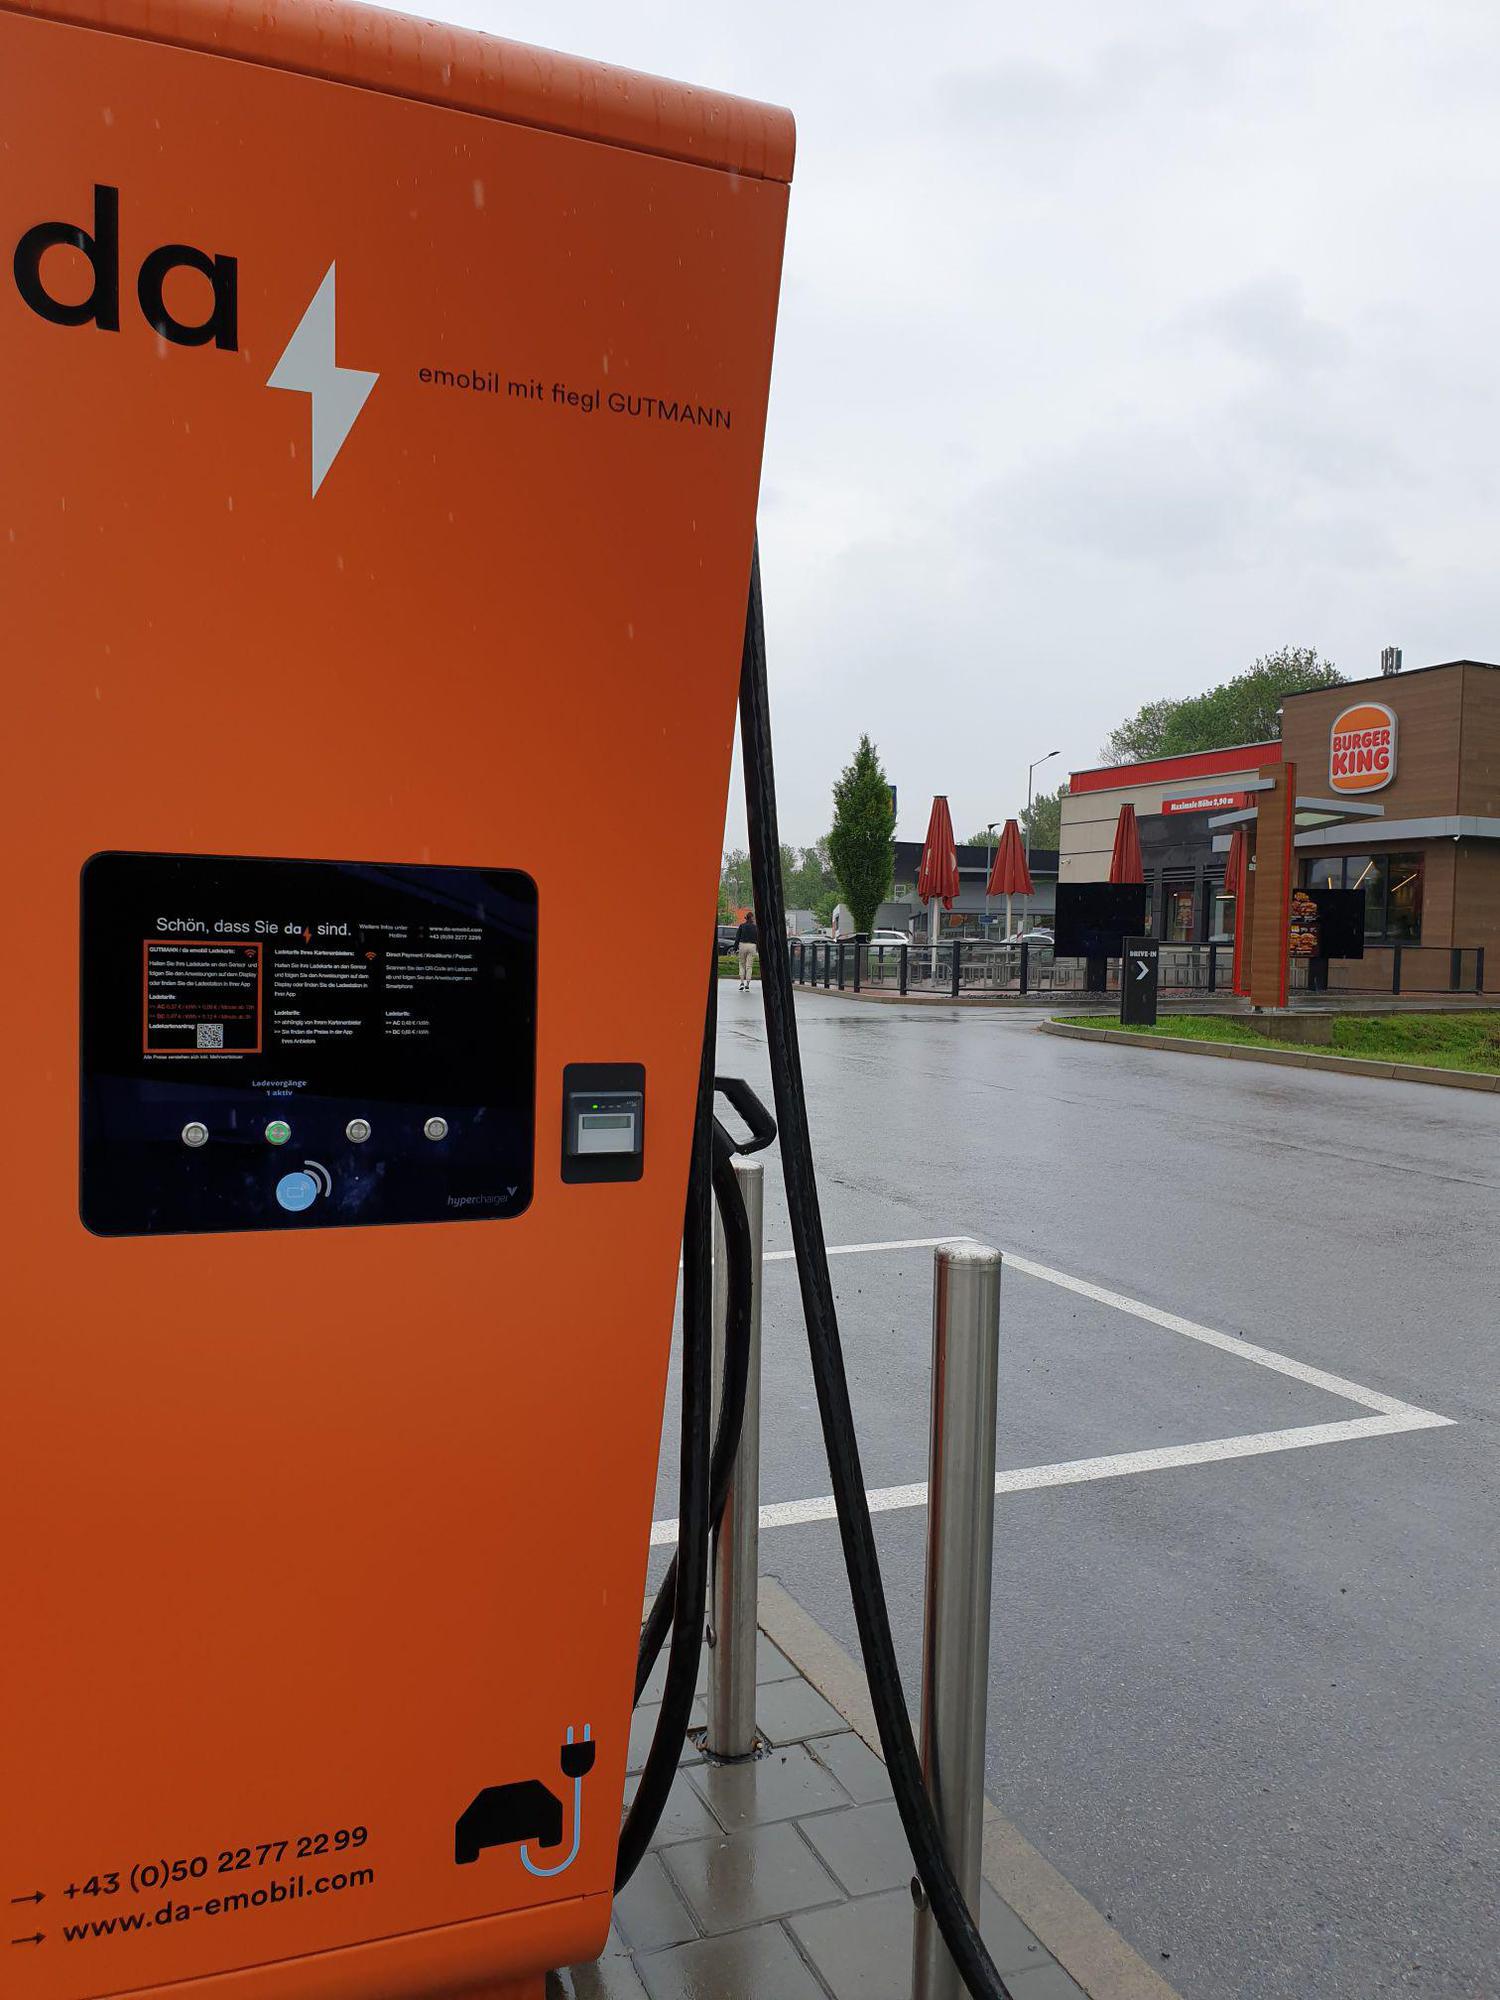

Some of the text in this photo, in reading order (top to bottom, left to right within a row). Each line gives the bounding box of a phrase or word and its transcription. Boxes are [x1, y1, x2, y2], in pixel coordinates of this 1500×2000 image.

[13, 183, 239, 352] da
[418, 367, 731, 430] emobil mit fiegl GUTMANN
[1333, 729, 1390, 752] BURGER
[1332, 747, 1390, 776] KING
[156, 917, 351, 936] Schön, dass Sie da sind.
[447, 1194, 508, 1208] hypercharger
[63, 1871, 120, 1900] +43
[130, 1855, 208, 1893] (0)50
[63, 1867, 374, 1942] www.da-emobil.com
